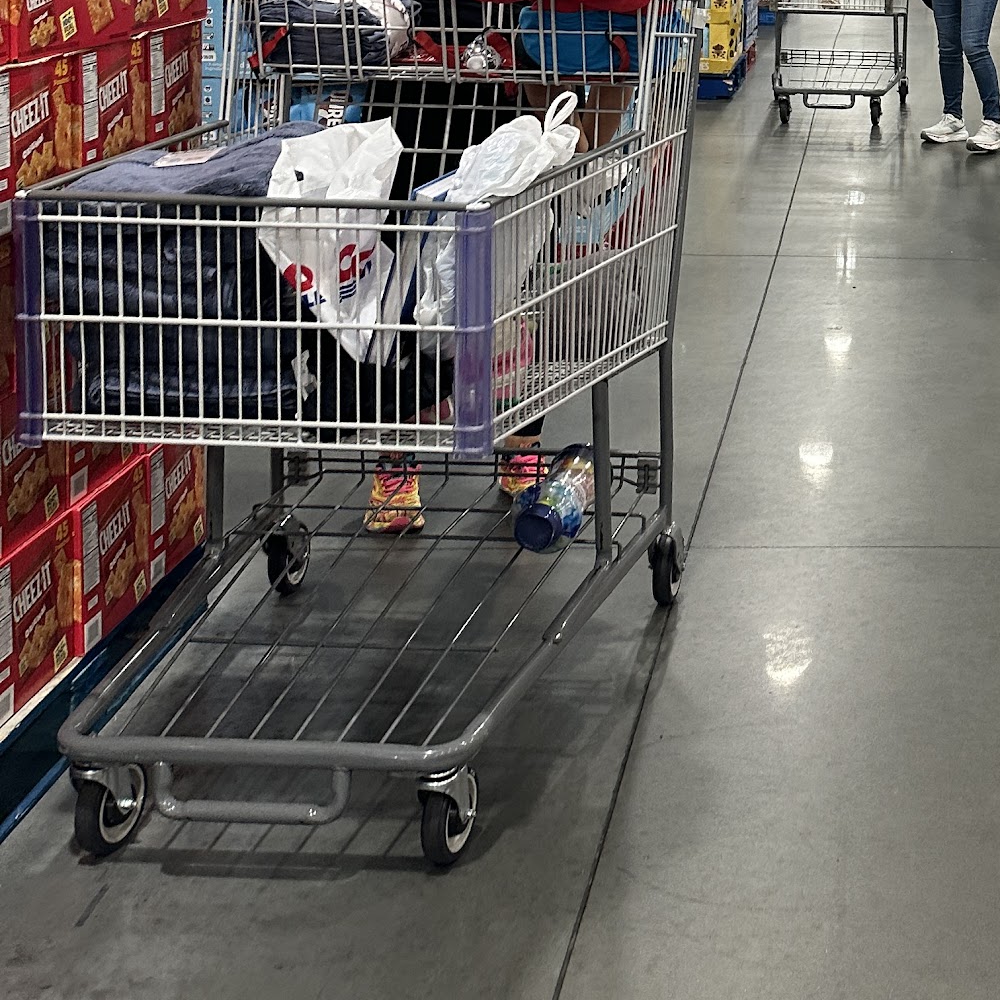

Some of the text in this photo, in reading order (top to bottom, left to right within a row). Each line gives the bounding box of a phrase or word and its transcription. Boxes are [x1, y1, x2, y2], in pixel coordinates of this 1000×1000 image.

[131, 41, 142, 58] 45
[54, 59, 68, 77] 45
[55, 520, 69, 541] 45
